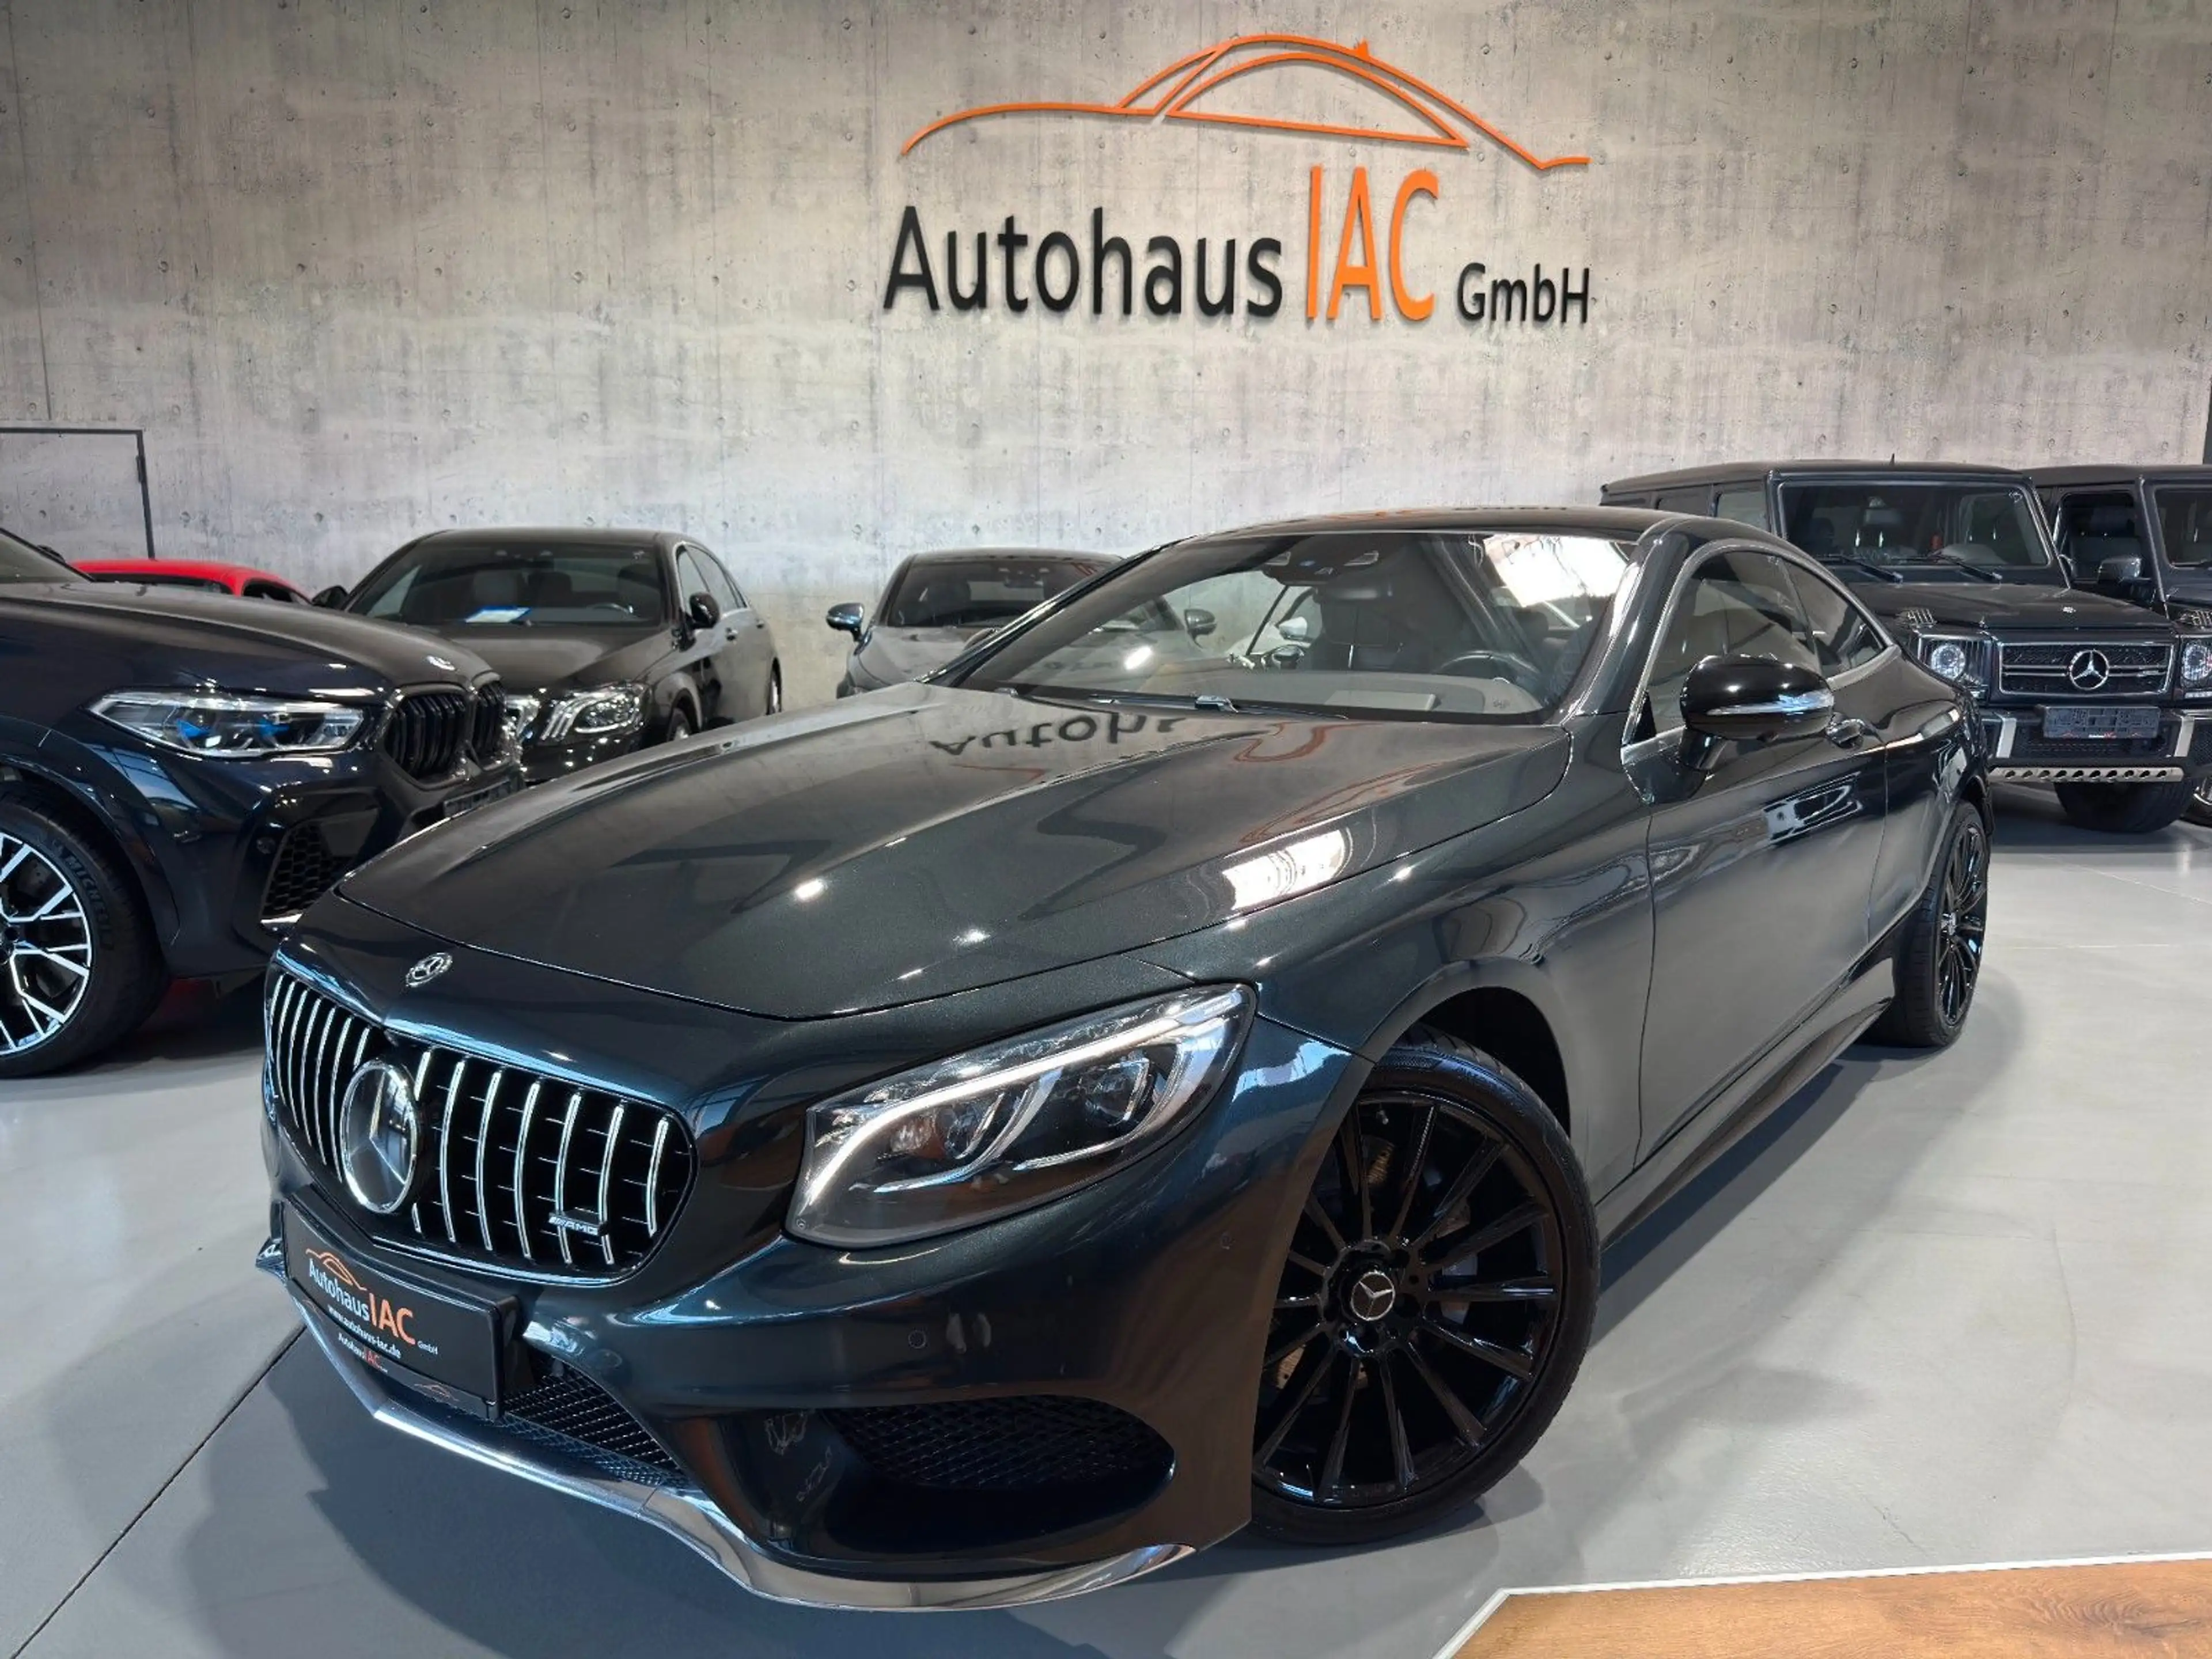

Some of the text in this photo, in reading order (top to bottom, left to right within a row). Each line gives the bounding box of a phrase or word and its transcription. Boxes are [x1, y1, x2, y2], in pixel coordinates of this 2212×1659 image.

[883, 166, 1589, 323] Autohaus IAC GmbH
[564, 1220, 599, 1236] AMG
[309, 1257, 438, 1355] Autohaus IAC GmbH
